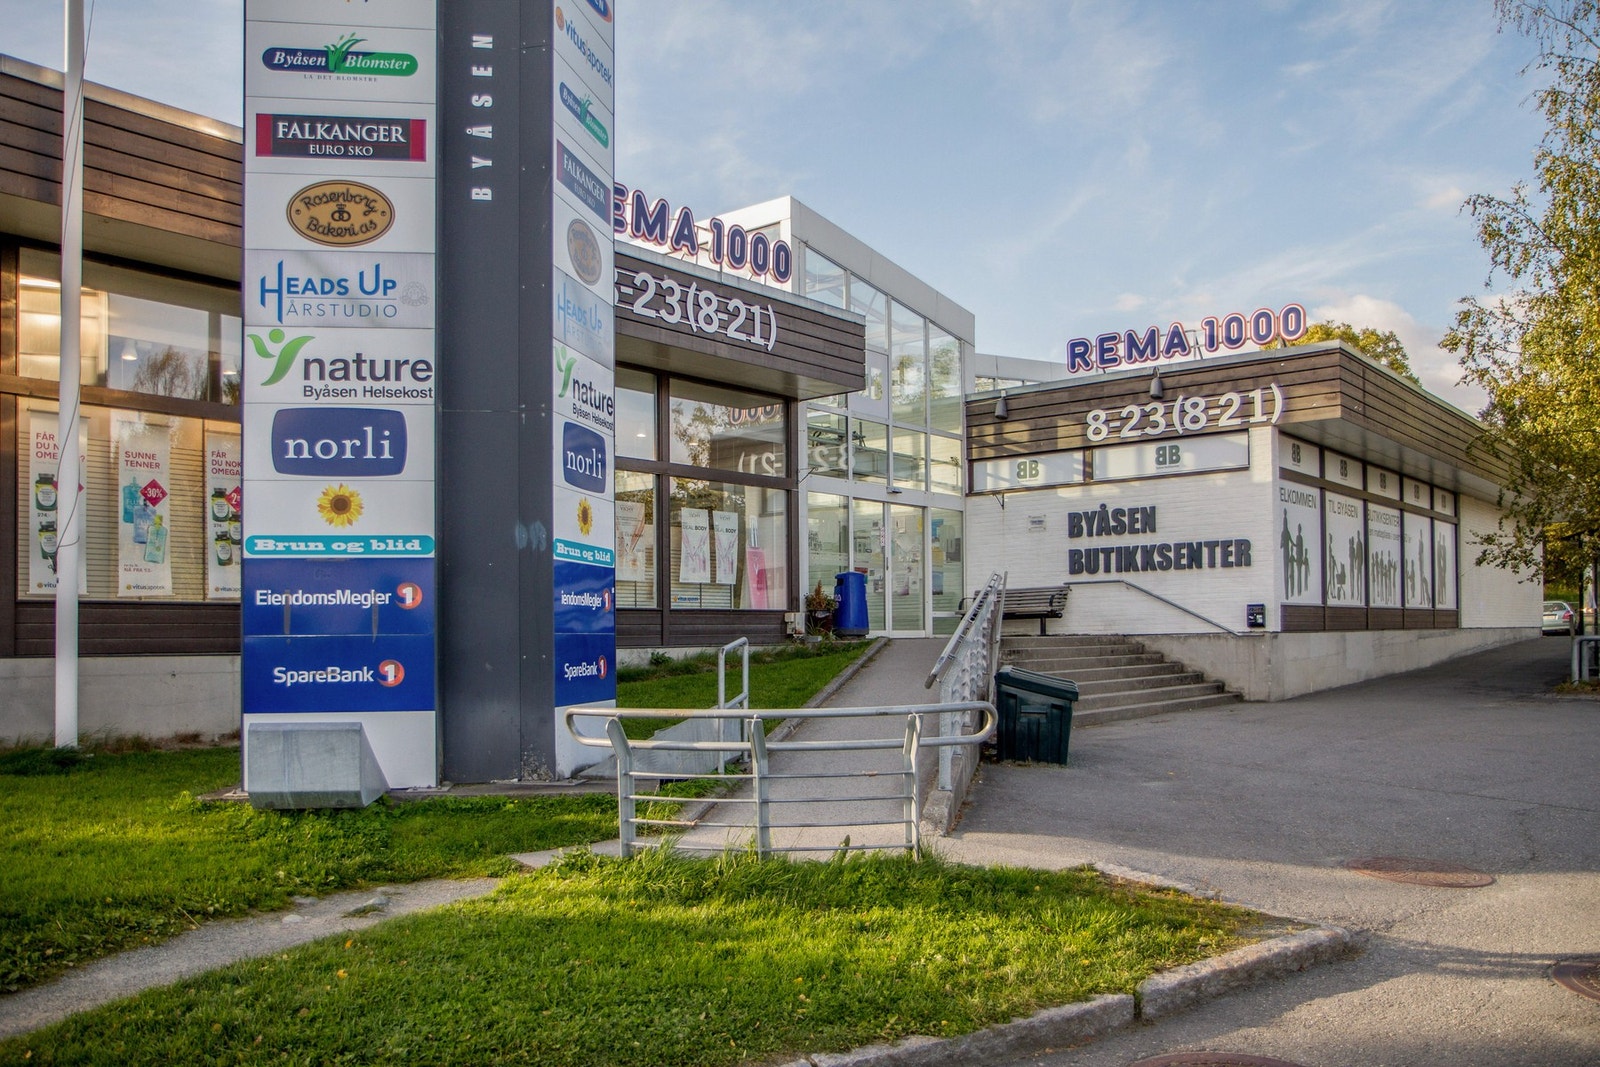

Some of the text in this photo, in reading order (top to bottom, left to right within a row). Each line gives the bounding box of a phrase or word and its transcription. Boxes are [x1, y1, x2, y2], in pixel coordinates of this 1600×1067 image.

[273, 51, 410, 70] Byåsen Blomster
[466, 34, 493, 201] BYÅSEN
[277, 121, 407, 144] FALKANGER
[309, 144, 374, 157] EURO SKO
[564, 153, 606, 205] FALKANGER
[302, 187, 378, 217] Rosenborg
[306, 216, 358, 237] Bakeri
[614, 182, 792, 284] EMA 1000
[614, 271, 777, 352] -23(8-21)
[1066, 303, 1307, 374] REMA 1000
[303, 352, 434, 383] nature
[303, 384, 434, 400] Byåsen Helsekost
[572, 377, 614, 417] nature
[572, 402, 614, 432] Byåsen Helsekost
[1086, 383, 1283, 442] 8-23(8-21)
[35, 431, 55, 442] FÅR
[35, 442, 50, 450] DU
[284, 426, 394, 460] norli
[35, 451, 59, 461] OME
[124, 451, 157, 461] SUNNE
[124, 459, 161, 470] TENNER
[211, 449, 227, 459] FÅR
[211, 459, 223, 467] DU
[566, 447, 603, 480] norli
[144, 487, 163, 499] -30%
[1279, 487, 1318, 509] ELKOMMEN
[1068, 503, 1157, 538] BYÅSEN
[254, 538, 422, 553] Brun og blid
[556, 542, 611, 562] Brun og blid
[1068, 538, 1252, 575] BUTIKKSENTER
[255, 589, 392, 609] EiendomsMegler
[273, 665, 375, 687] SpareBank
[564, 661, 598, 681] SpareBank
